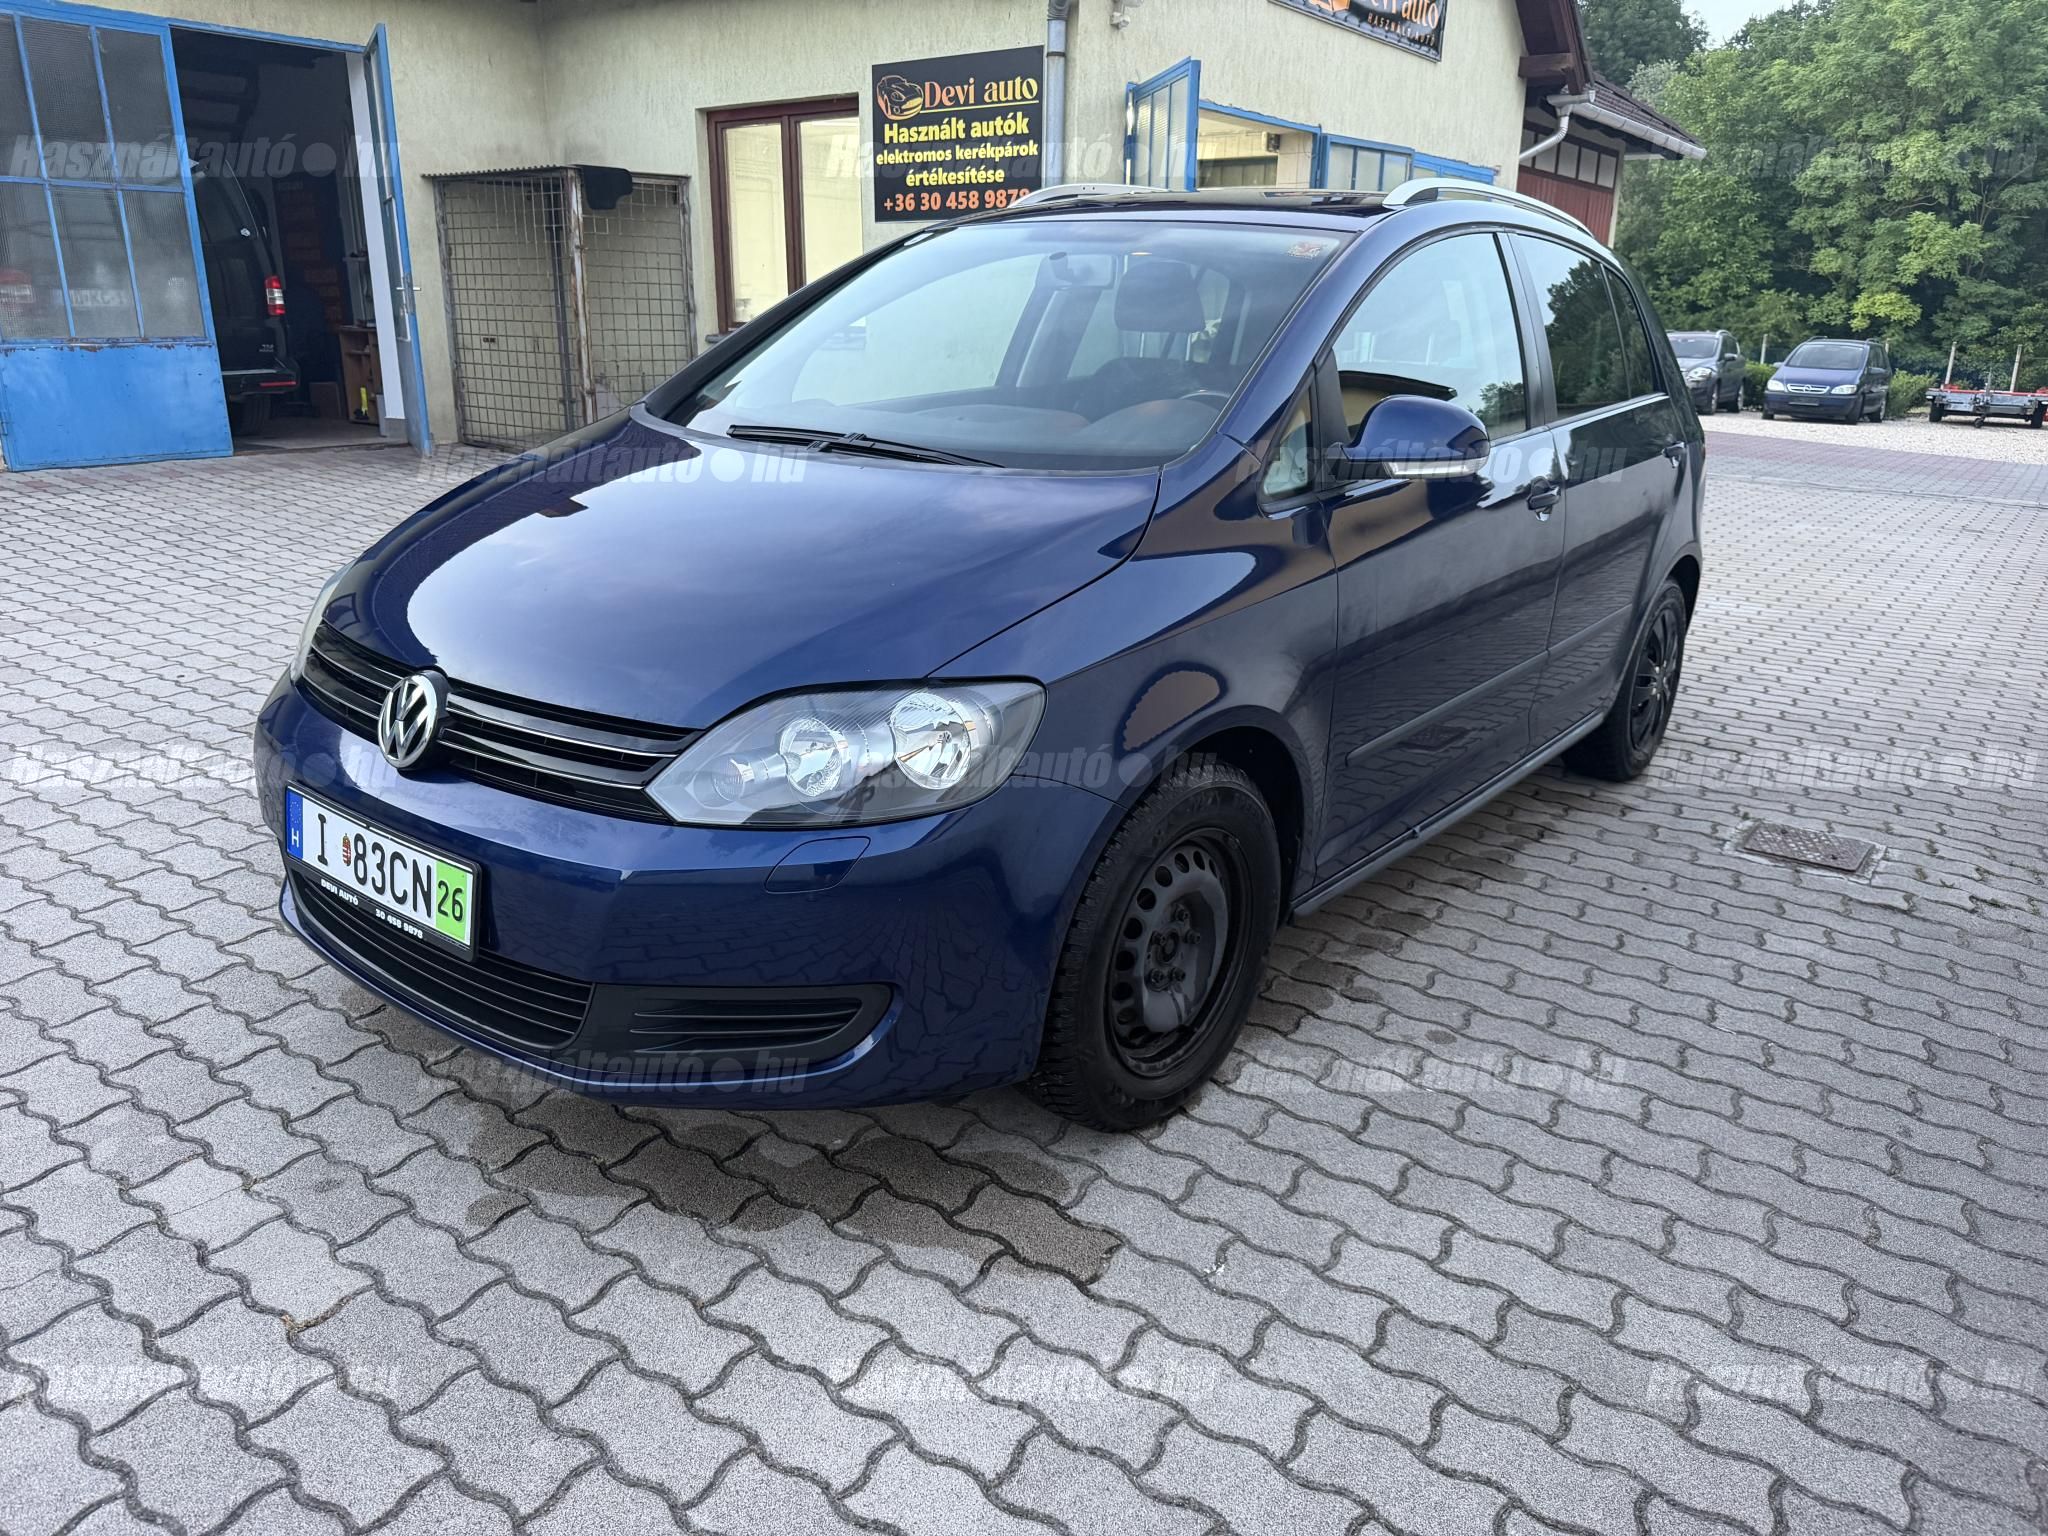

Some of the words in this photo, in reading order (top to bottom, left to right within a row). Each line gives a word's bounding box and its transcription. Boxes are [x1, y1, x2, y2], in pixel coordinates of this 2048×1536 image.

[924, 77, 975, 109] Devi
[984, 76, 1038, 102] auto
[884, 117, 966, 145] Használt
[971, 111, 1030, 139] autók
[876, 147, 952, 165] elektromos
[955, 140, 1039, 162] kerékpárok
[906, 165, 1005, 187] értékesítése
[884, 193, 915, 212] +36
[920, 192, 941, 211] 30
[946, 190, 979, 210] 458
[291, 828, 300, 848] H
[353, 833, 432, 918] 83CN
[437, 880, 464, 922] 26
[321, 878, 338, 894] DEVI
[339, 889, 359, 906] AUTÓ
